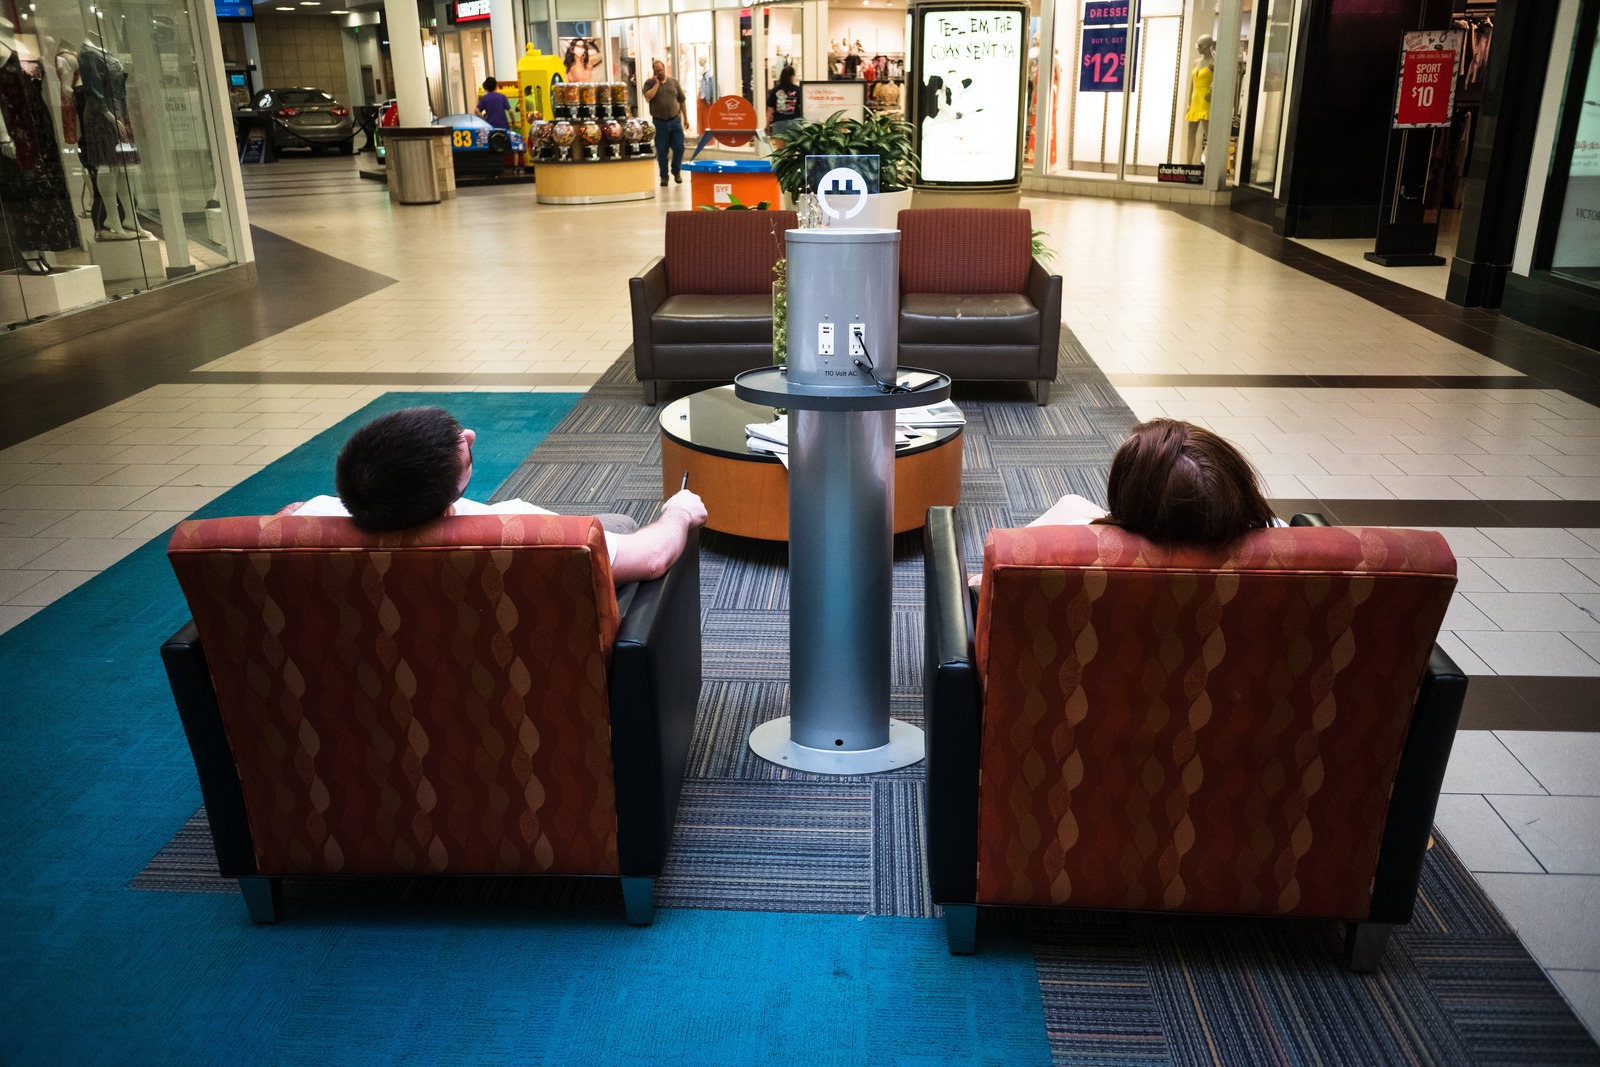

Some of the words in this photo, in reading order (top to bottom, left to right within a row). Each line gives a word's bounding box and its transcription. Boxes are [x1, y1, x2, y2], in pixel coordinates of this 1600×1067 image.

[1090, 7, 1128, 18] DRESSE
[994, 16, 1012, 33] THE
[931, 43, 961, 61] COWS
[966, 40, 998, 60] SENT
[1003, 41, 1015, 58] YA
[1416, 63, 1442, 74] SPORT
[1416, 73, 1439, 83] BRAS
[1411, 86, 1434, 107] $10
[453, 130, 472, 147] 83
[1159, 166, 1185, 175] charlotte
[716, 185, 729, 193] SYF
